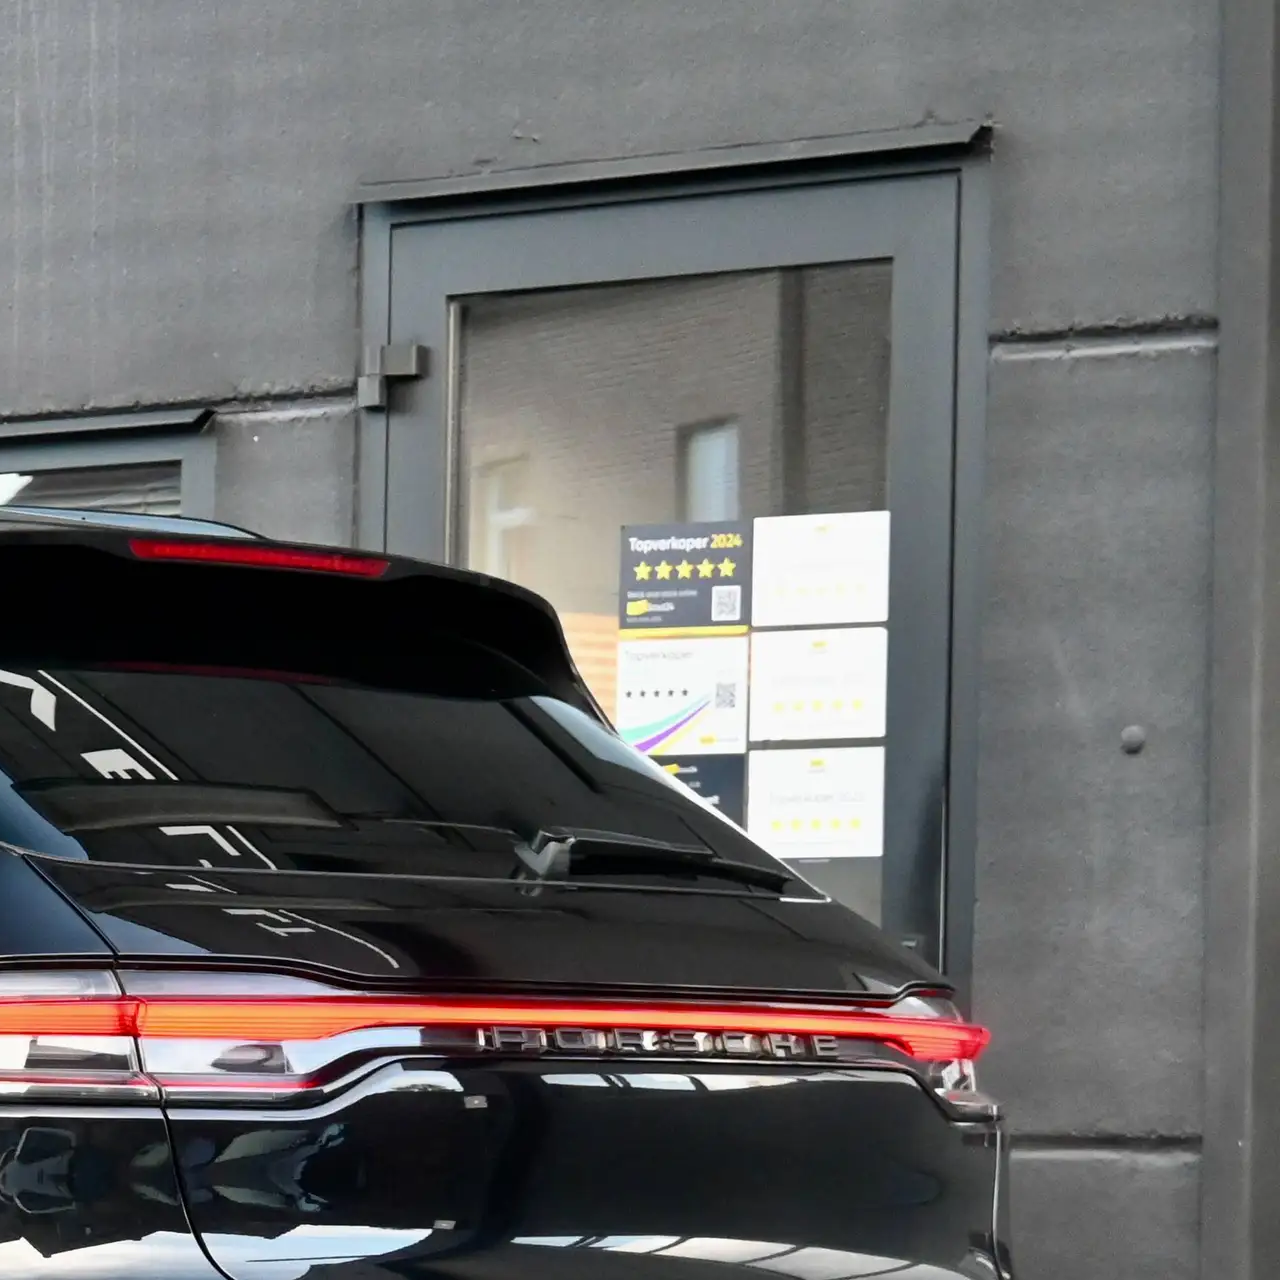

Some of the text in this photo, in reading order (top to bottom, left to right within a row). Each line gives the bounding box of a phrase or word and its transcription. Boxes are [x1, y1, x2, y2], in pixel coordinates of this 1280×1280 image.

[628, 533, 743, 554] Topverkoper 2024
[490, 1025, 840, 1058] PORSCHE
